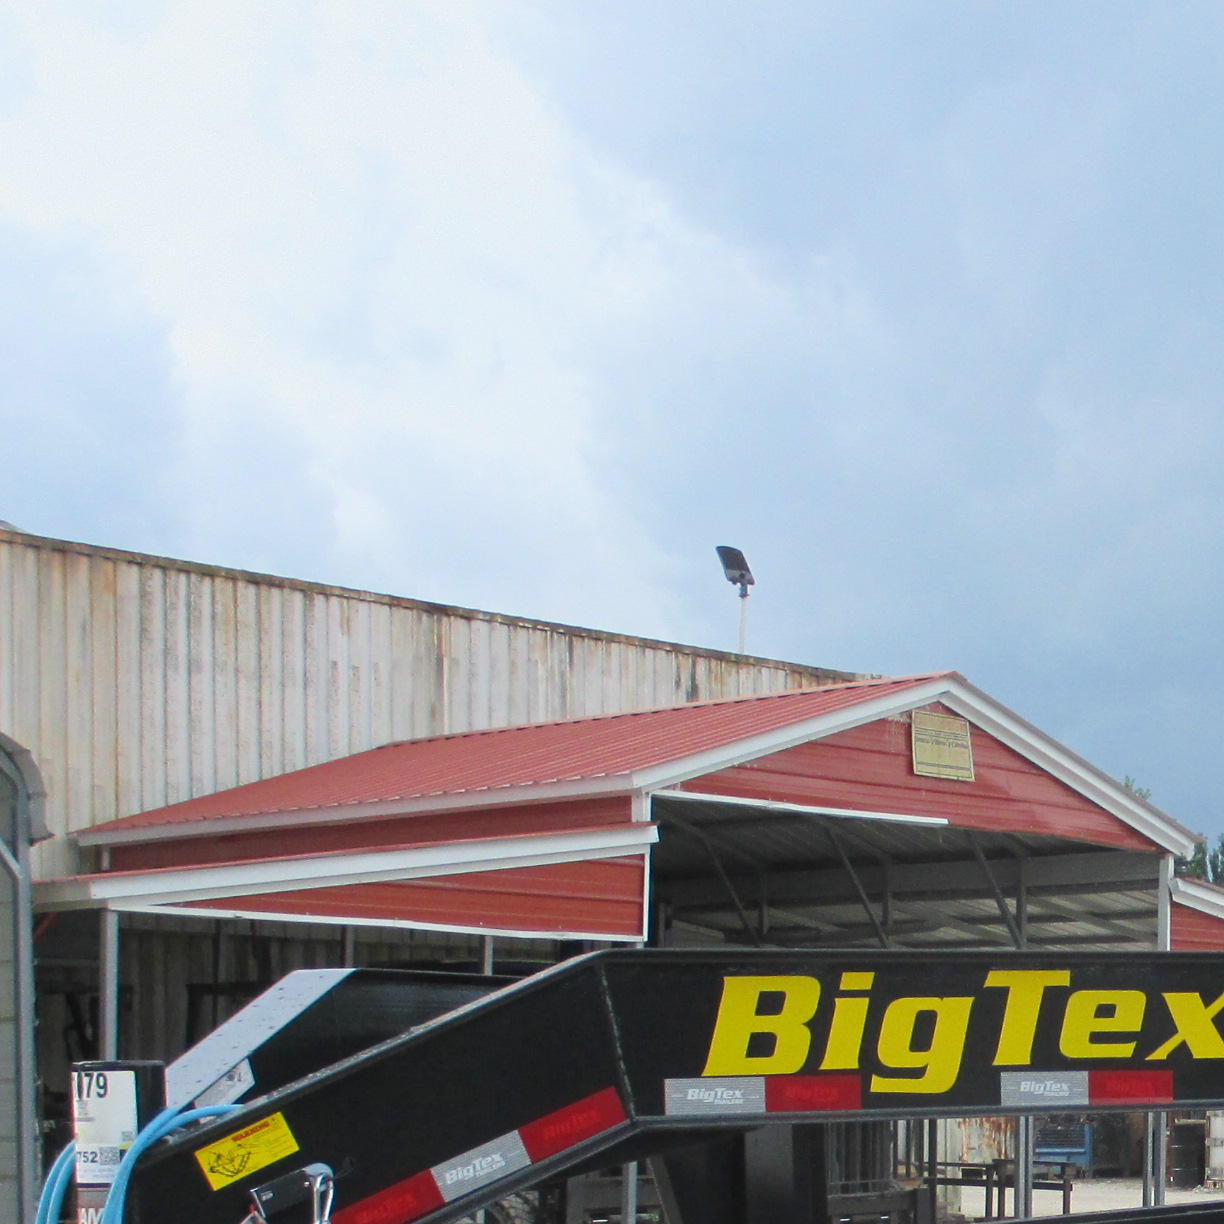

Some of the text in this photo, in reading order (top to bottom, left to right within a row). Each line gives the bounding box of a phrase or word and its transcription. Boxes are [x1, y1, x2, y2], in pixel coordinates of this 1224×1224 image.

[686, 1087, 745, 1103] BigTex
[1019, 1080, 1070, 1095] BigTex
[444, 1153, 504, 1185] BigTex
